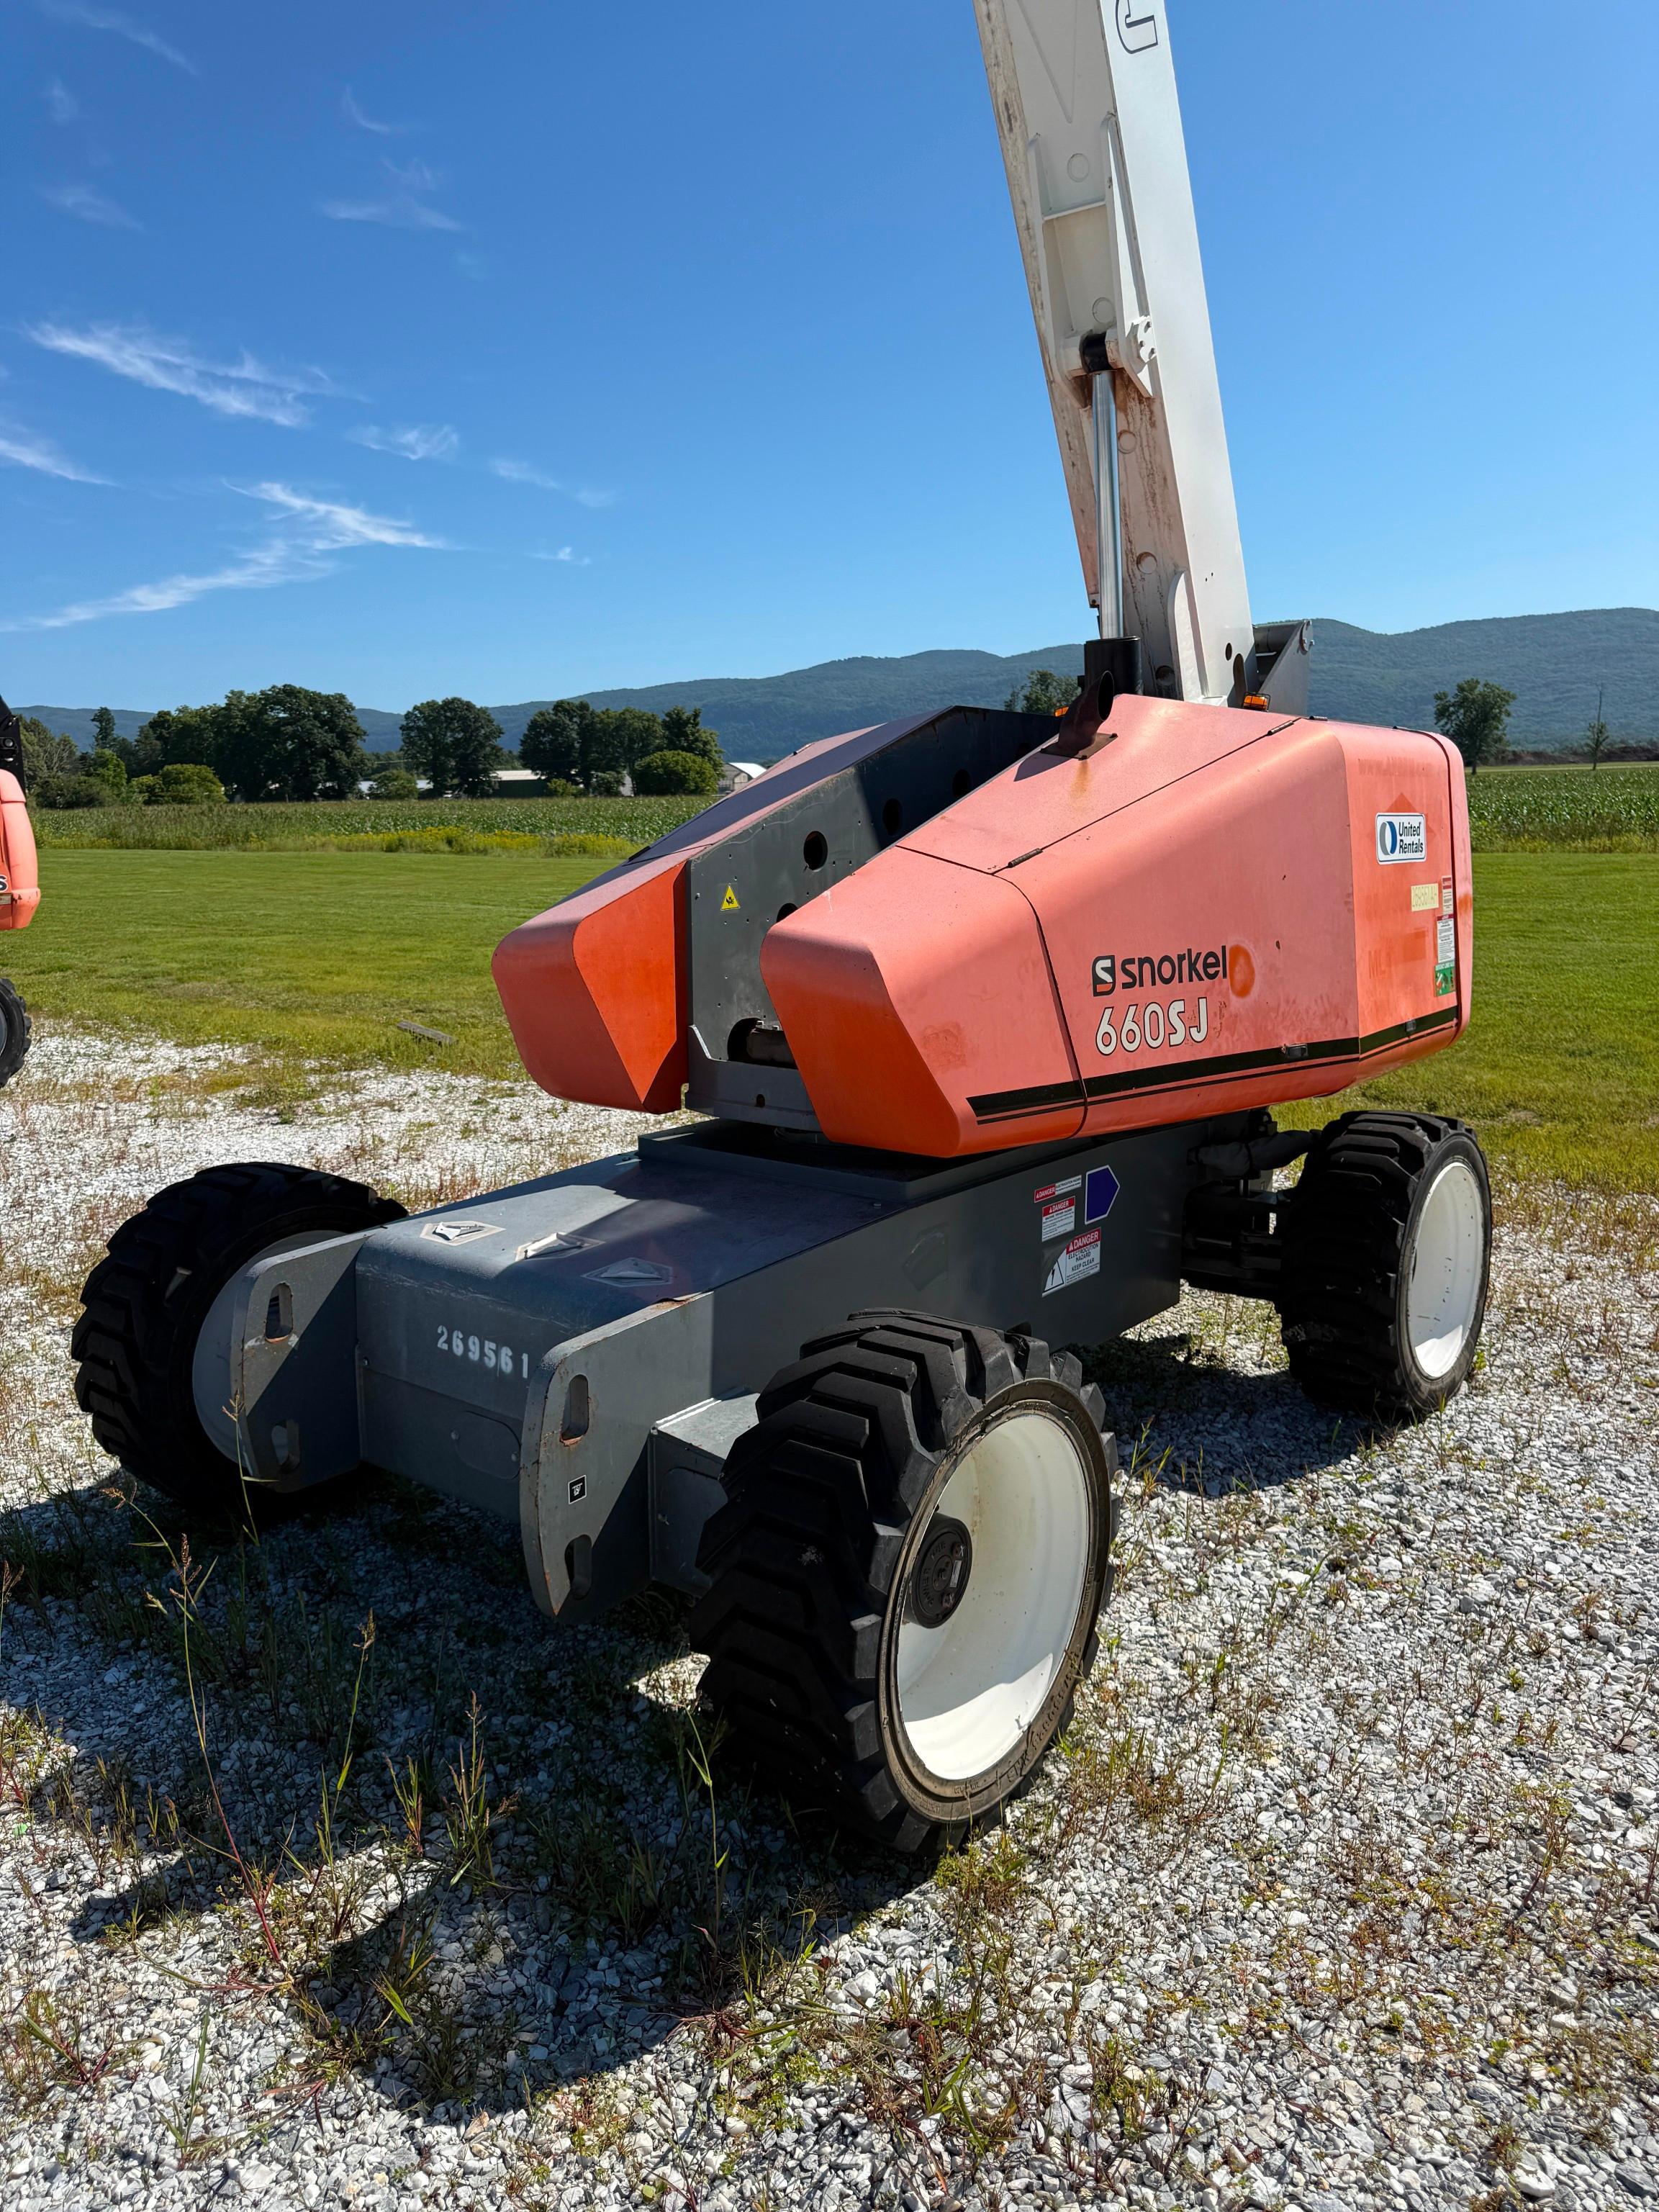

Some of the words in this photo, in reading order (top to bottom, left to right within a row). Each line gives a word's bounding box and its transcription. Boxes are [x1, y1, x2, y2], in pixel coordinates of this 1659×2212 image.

[1398, 821, 1421, 837] United
[1398, 839, 1424, 854] Rentals
[1121, 945, 1227, 990] snorkel
[1095, 997, 1208, 1056] 660SJ
[1039, 1187, 1055, 1196] DANGER
[1052, 1201, 1069, 1212] DANGER
[1073, 1231, 1098, 1249] DANGER
[1068, 1243, 1098, 1260] ELECTROCUTION
[1075, 1252, 1090, 1263] HAZARD
[1071, 1263, 1082, 1273] KEEP
[1082, 1258, 1095, 1268] CLEAR
[437, 1325, 529, 1378] 269561
